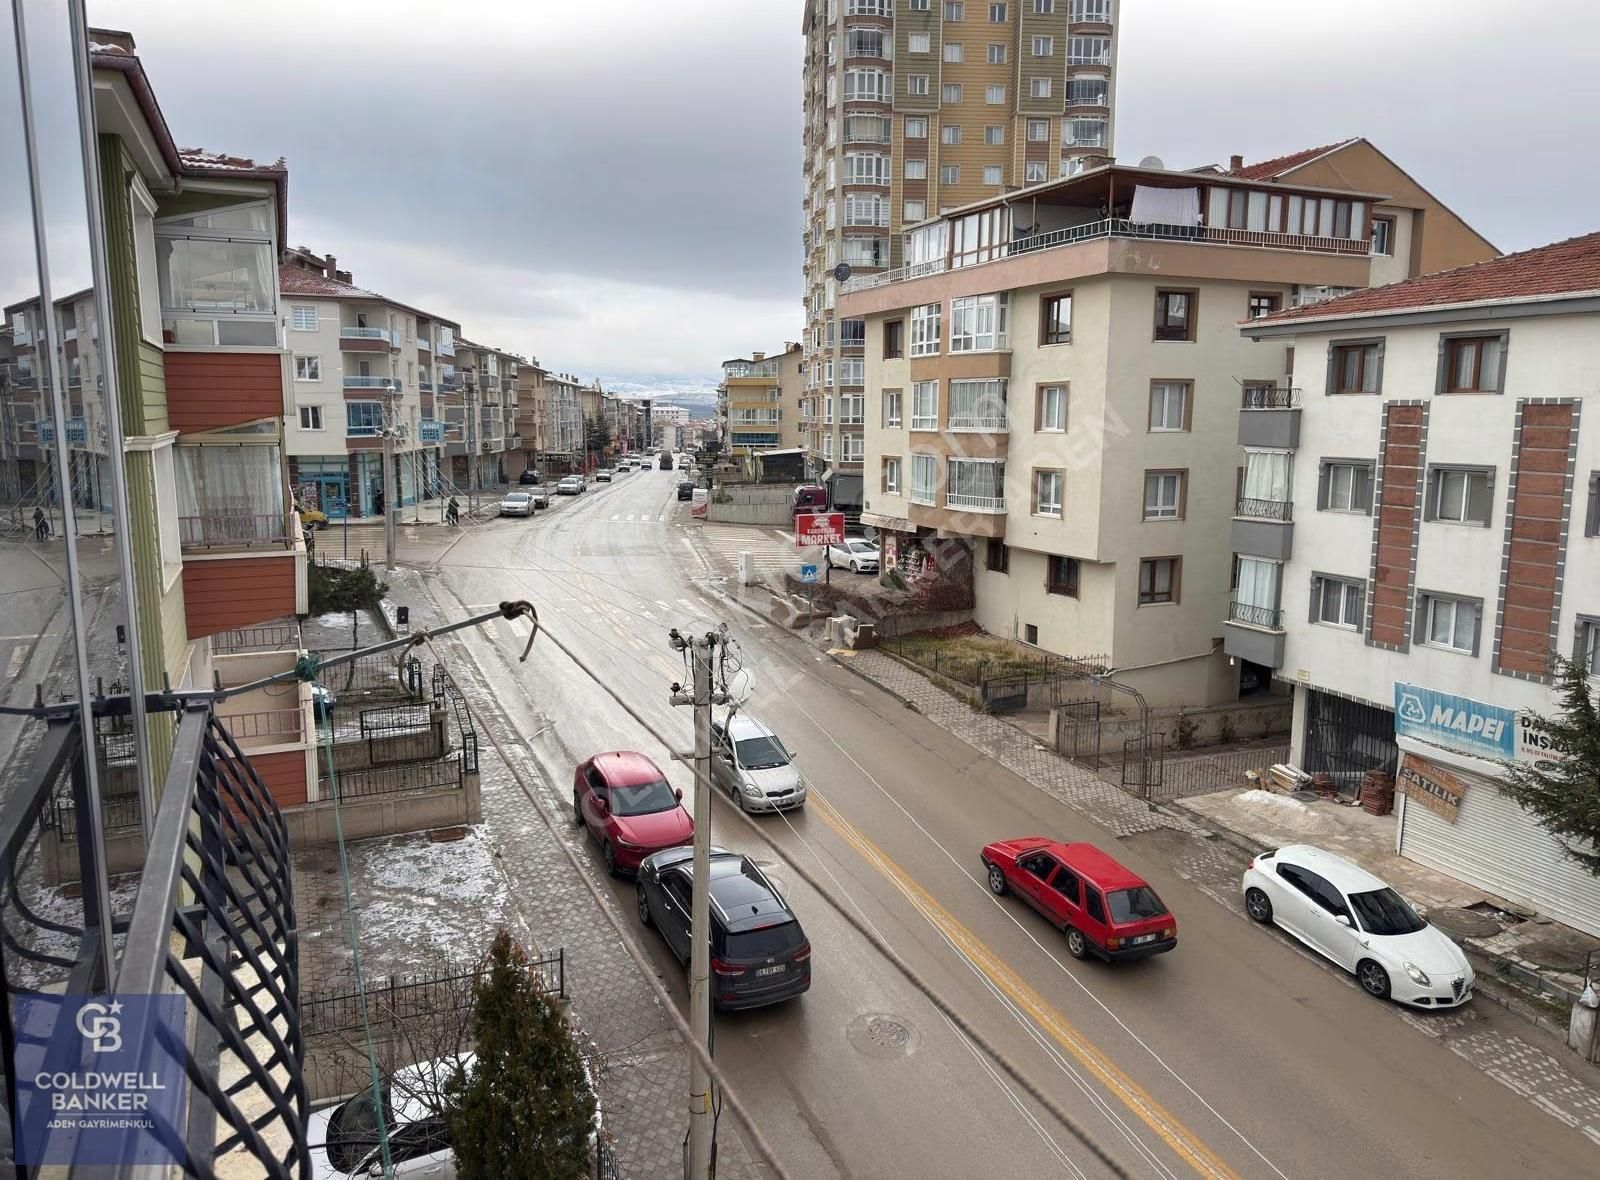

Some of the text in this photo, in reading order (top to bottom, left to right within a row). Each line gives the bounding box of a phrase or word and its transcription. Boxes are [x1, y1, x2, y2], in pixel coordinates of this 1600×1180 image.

[801, 534, 841, 545] MARKET
[1430, 704, 1505, 742] MAPEI
[1403, 768, 1458, 806] SATILIK
